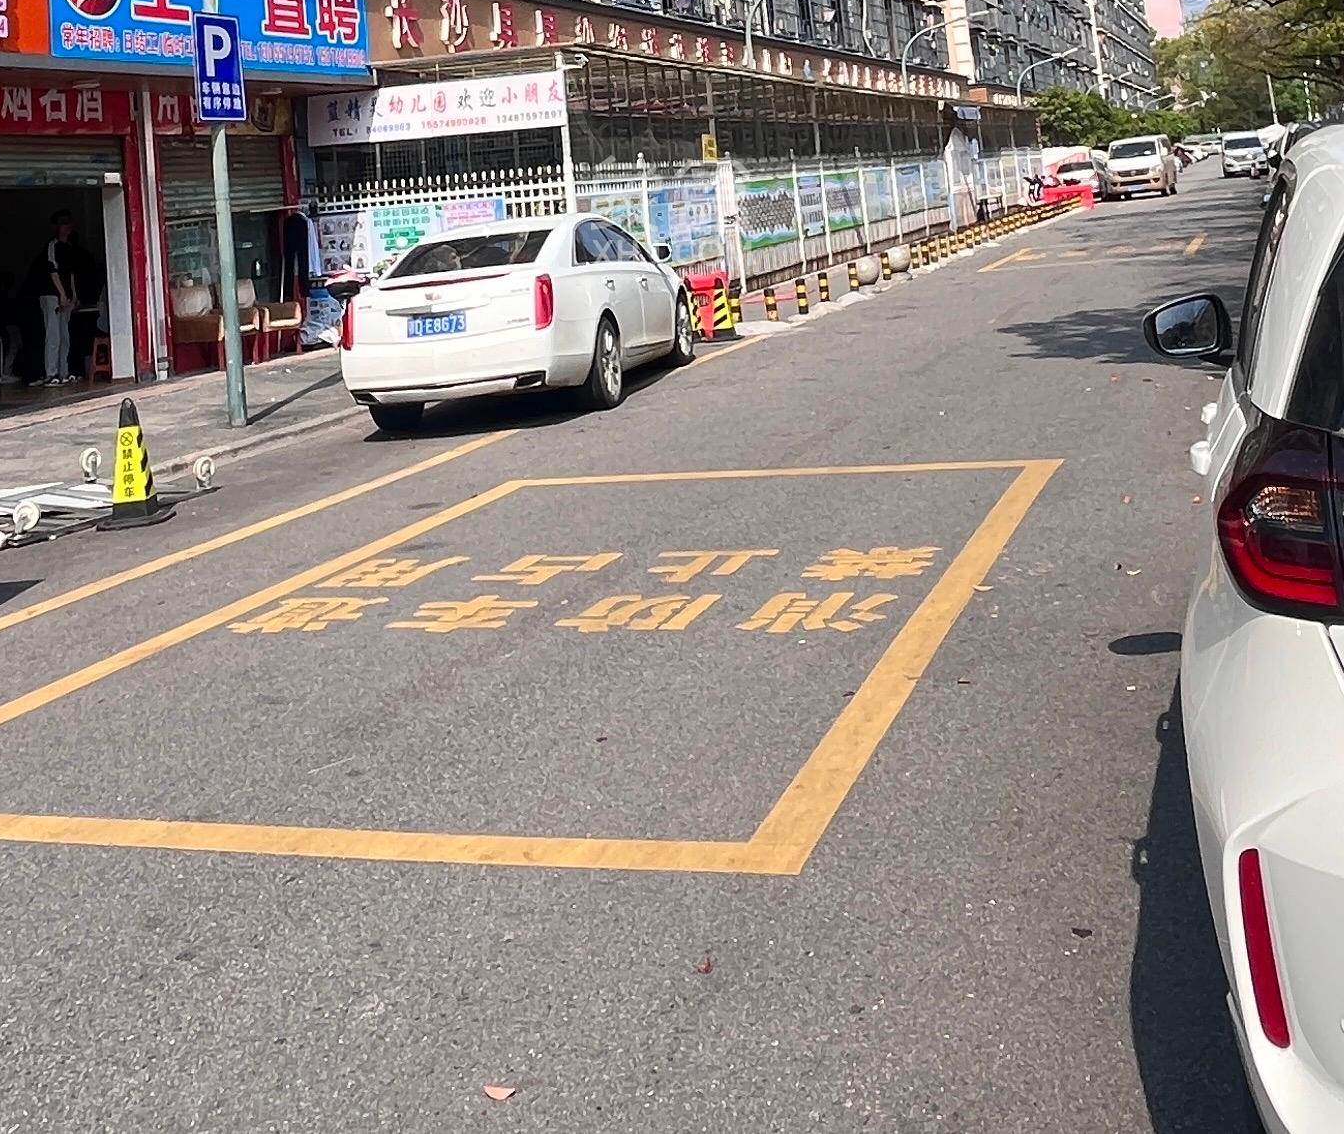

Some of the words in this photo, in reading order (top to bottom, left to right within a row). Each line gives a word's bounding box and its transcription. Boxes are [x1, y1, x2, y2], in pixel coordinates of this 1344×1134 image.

[204, 25, 232, 78] P
[119, 446, 137, 500] 禁止停车
